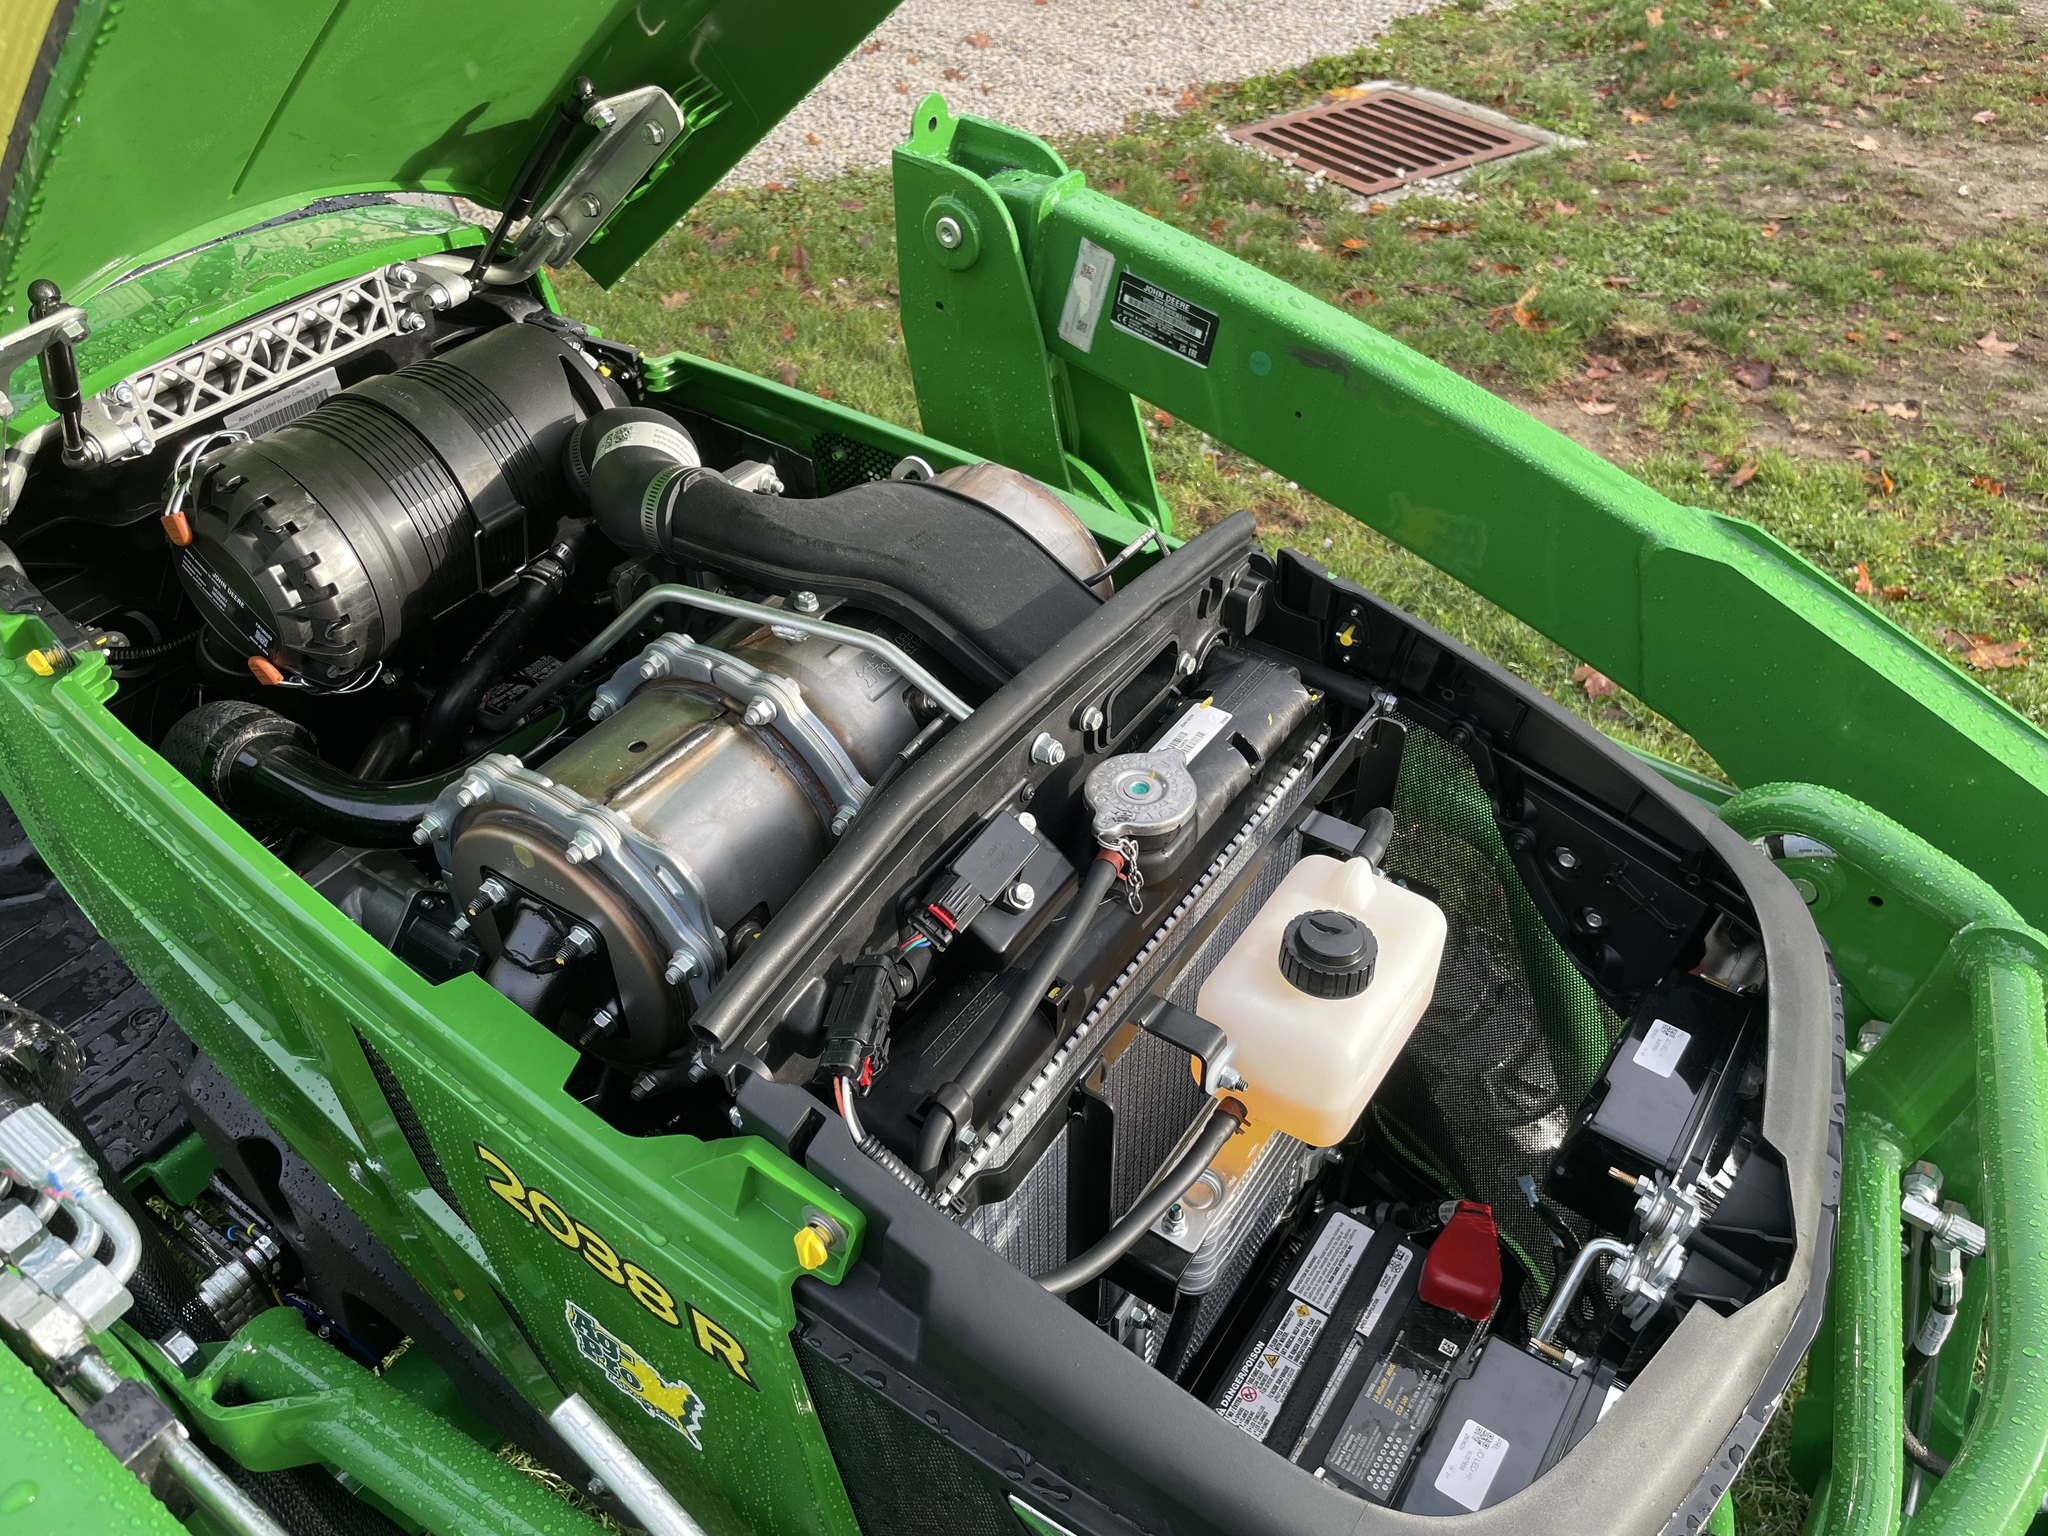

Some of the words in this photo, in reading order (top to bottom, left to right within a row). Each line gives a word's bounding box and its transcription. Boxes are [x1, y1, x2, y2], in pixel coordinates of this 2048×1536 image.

[1144, 285, 1164, 298] JOHN
[1166, 294, 1190, 311] DEERE
[238, 410, 253, 422] Apply
[262, 400, 276, 410] Label
[282, 393, 291, 401] the
[291, 384, 310, 397] Console
[310, 380, 320, 388] Sub
[212, 572, 227, 590] JOHN
[227, 588, 245, 608] DEERE
[473, 1141, 682, 1328] 2038
[683, 1301, 761, 1393] R
[580, 1332, 644, 1392] Pro
[1220, 1340, 1265, 1407] DANGER/POISON
[1371, 1377, 1389, 1402] 18-MONTH
[1384, 1362, 1396, 1376] MOIS
[1382, 1397, 1393, 1409] 51R
[1394, 1404, 1404, 1415] CCA
[1399, 1394, 1409, 1406] 500
[1334, 1453, 1344, 1465] Deere
[1342, 1433, 1355, 1451] Company
[1343, 1452, 1352, 1461] John
[1348, 1442, 1357, 1453] Deere
[1353, 1432, 1362, 1443] Place
[1475, 1448, 1486, 1458] JD
[1468, 1457, 1481, 1472] LED
